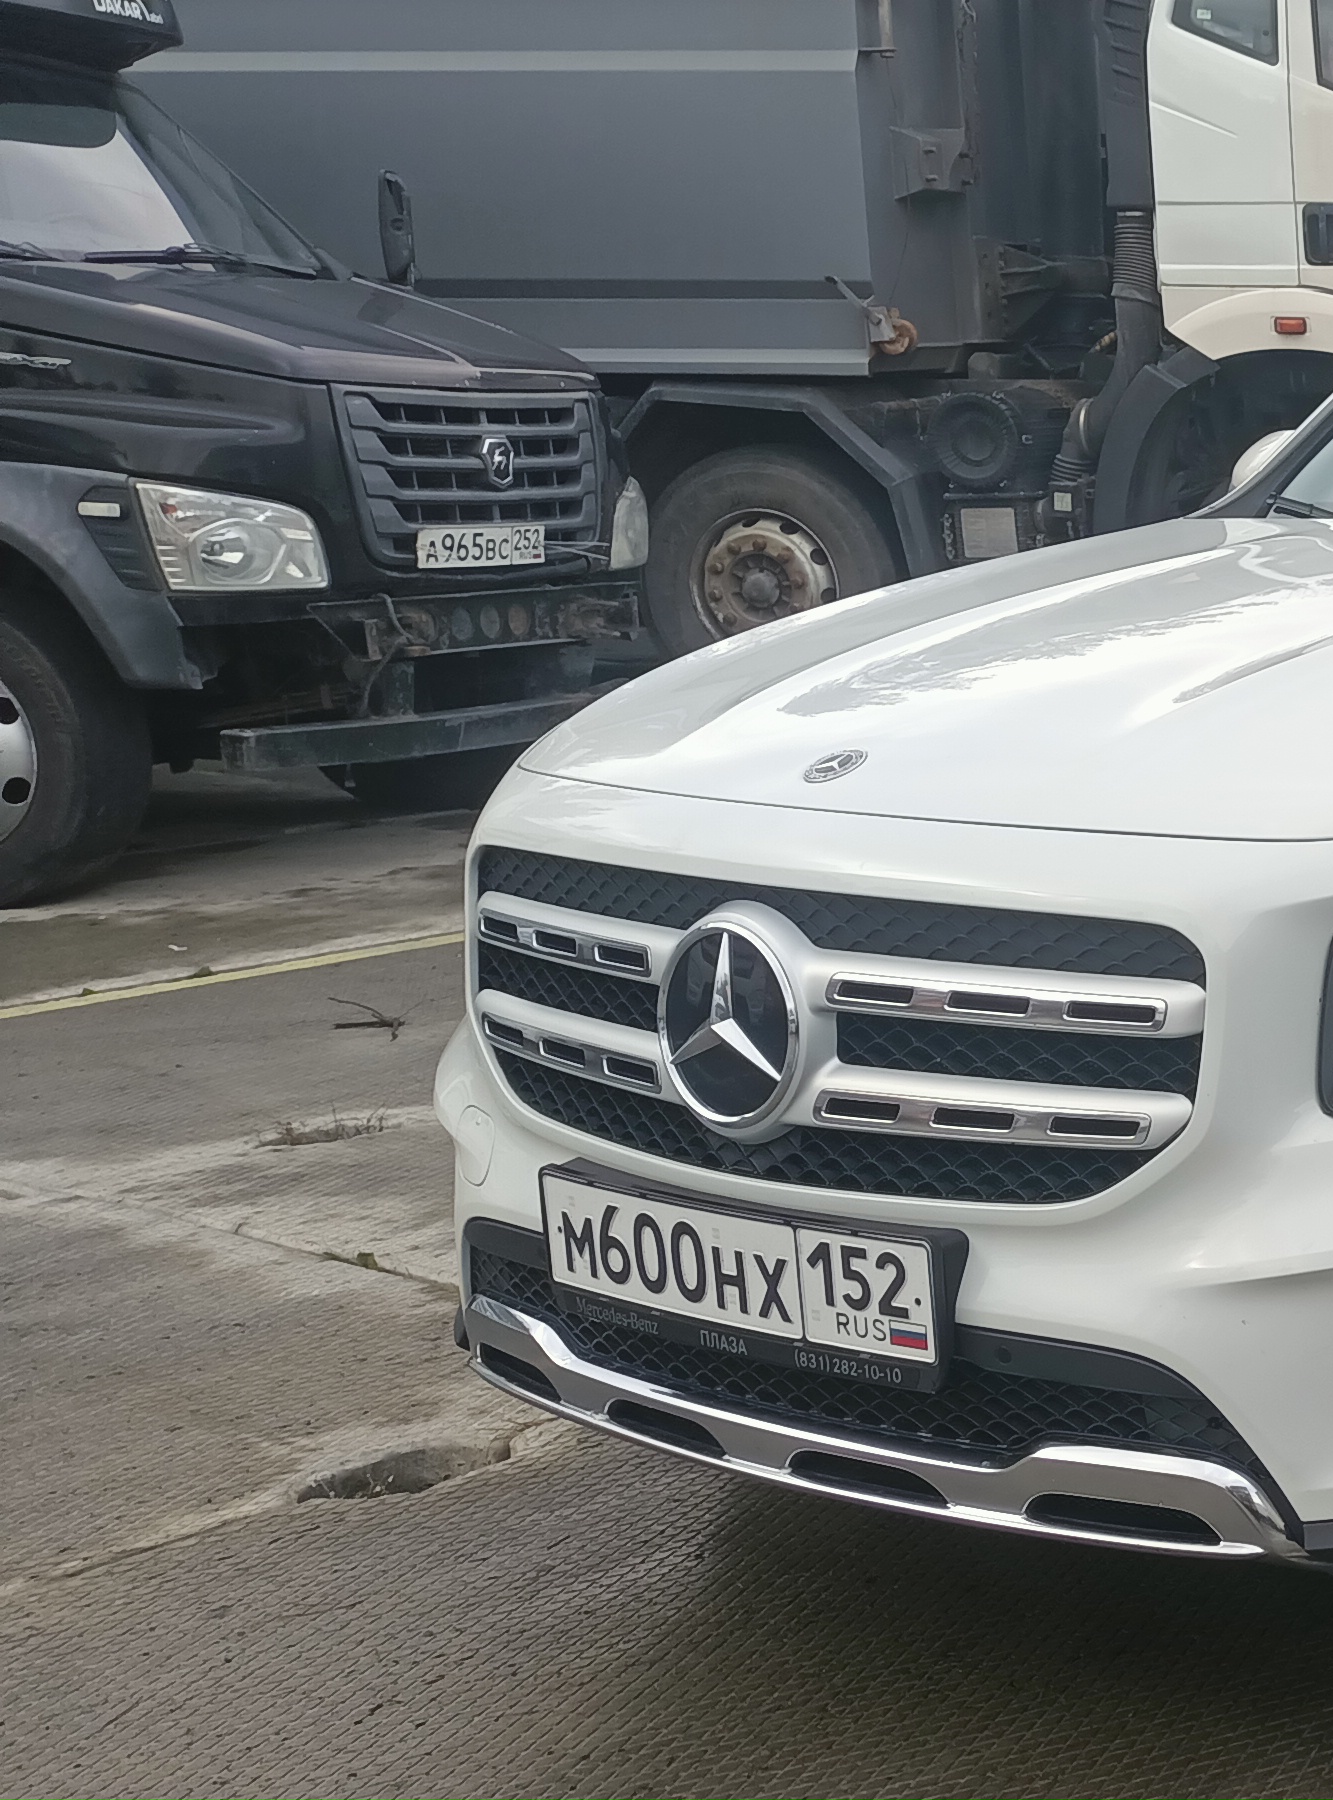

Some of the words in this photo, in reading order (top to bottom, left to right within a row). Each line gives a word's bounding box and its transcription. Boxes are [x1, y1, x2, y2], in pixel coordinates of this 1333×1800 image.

[426, 532, 510, 563] А965ВС
[513, 528, 540, 551] 252
[560, 1204, 794, 1324] М600НХ
[806, 1240, 910, 1320] 152
[575, 1297, 659, 1335] Mercedes-Benz
[836, 1312, 888, 1342] RUS
[700, 1329, 748, 1356] ПЛАЗА
